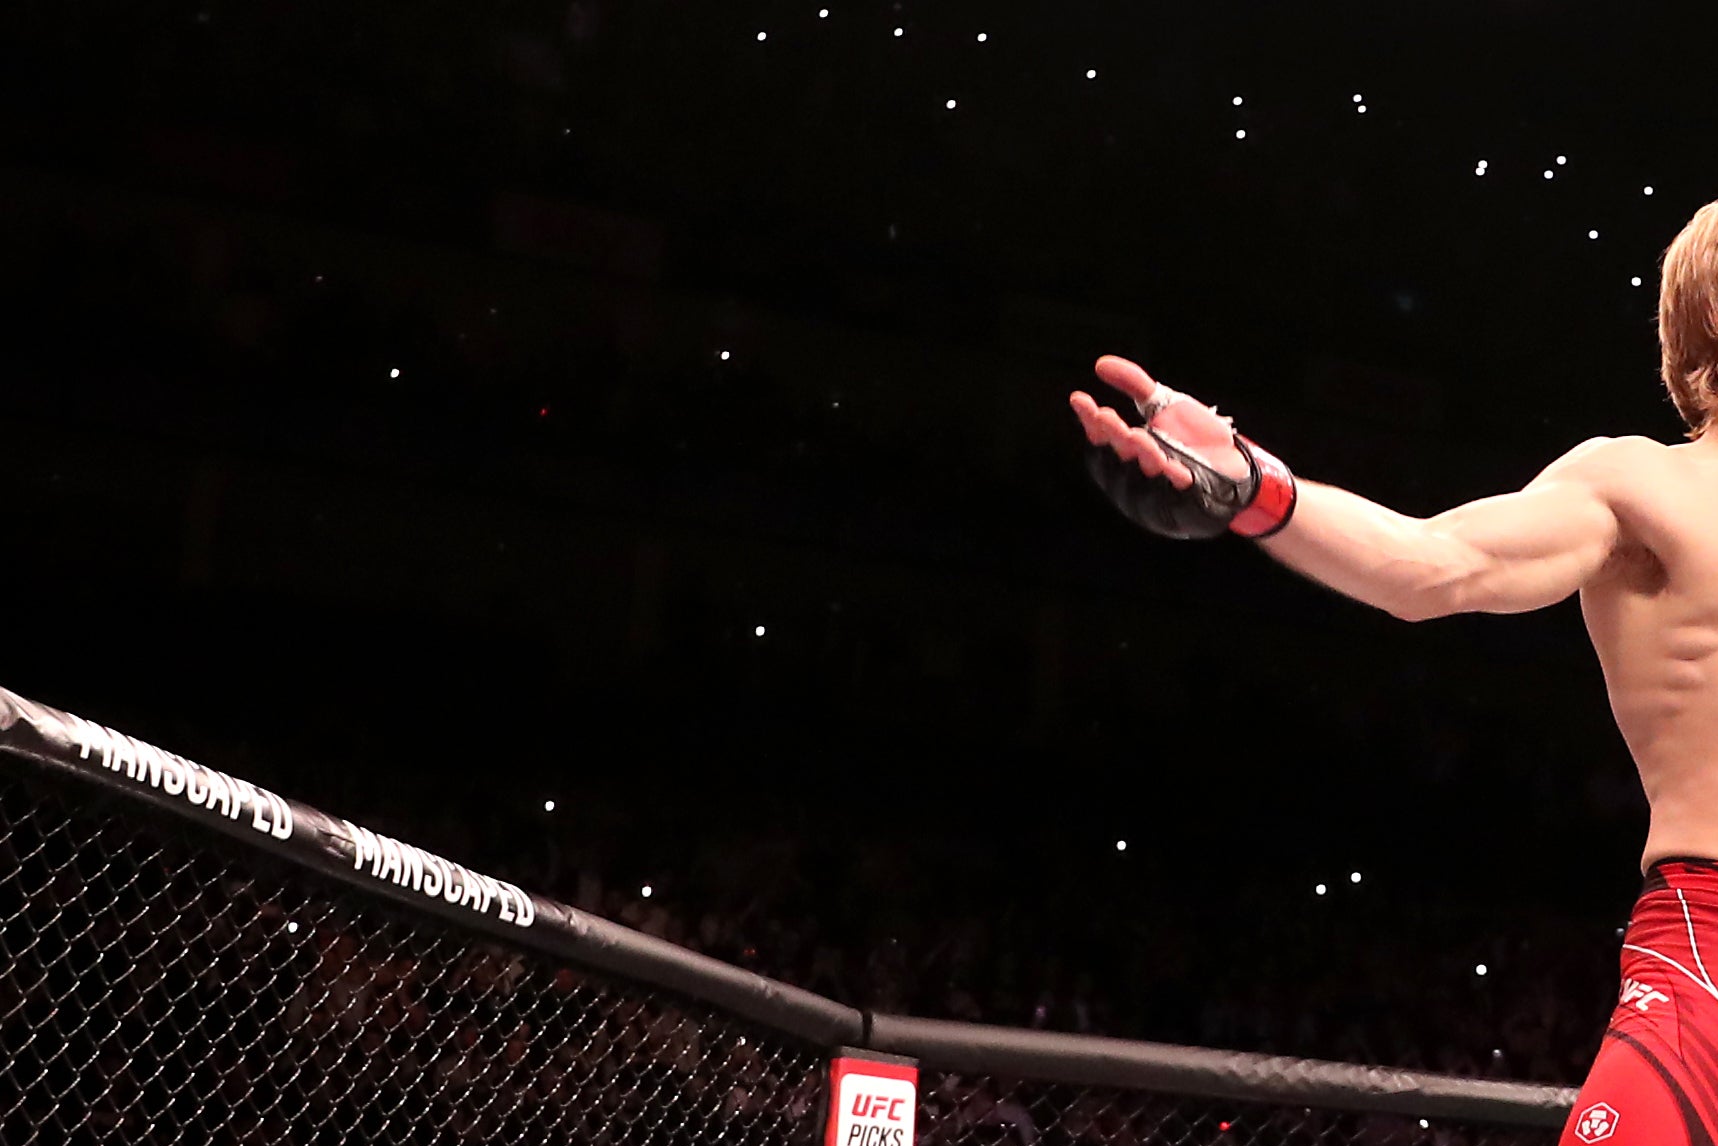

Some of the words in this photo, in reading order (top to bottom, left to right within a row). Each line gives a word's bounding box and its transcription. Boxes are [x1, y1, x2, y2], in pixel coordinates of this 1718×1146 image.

[68, 713, 294, 840] MANSCAPED
[343, 820, 535, 928] MANSCAPED
[851, 1093, 905, 1121] UFC
